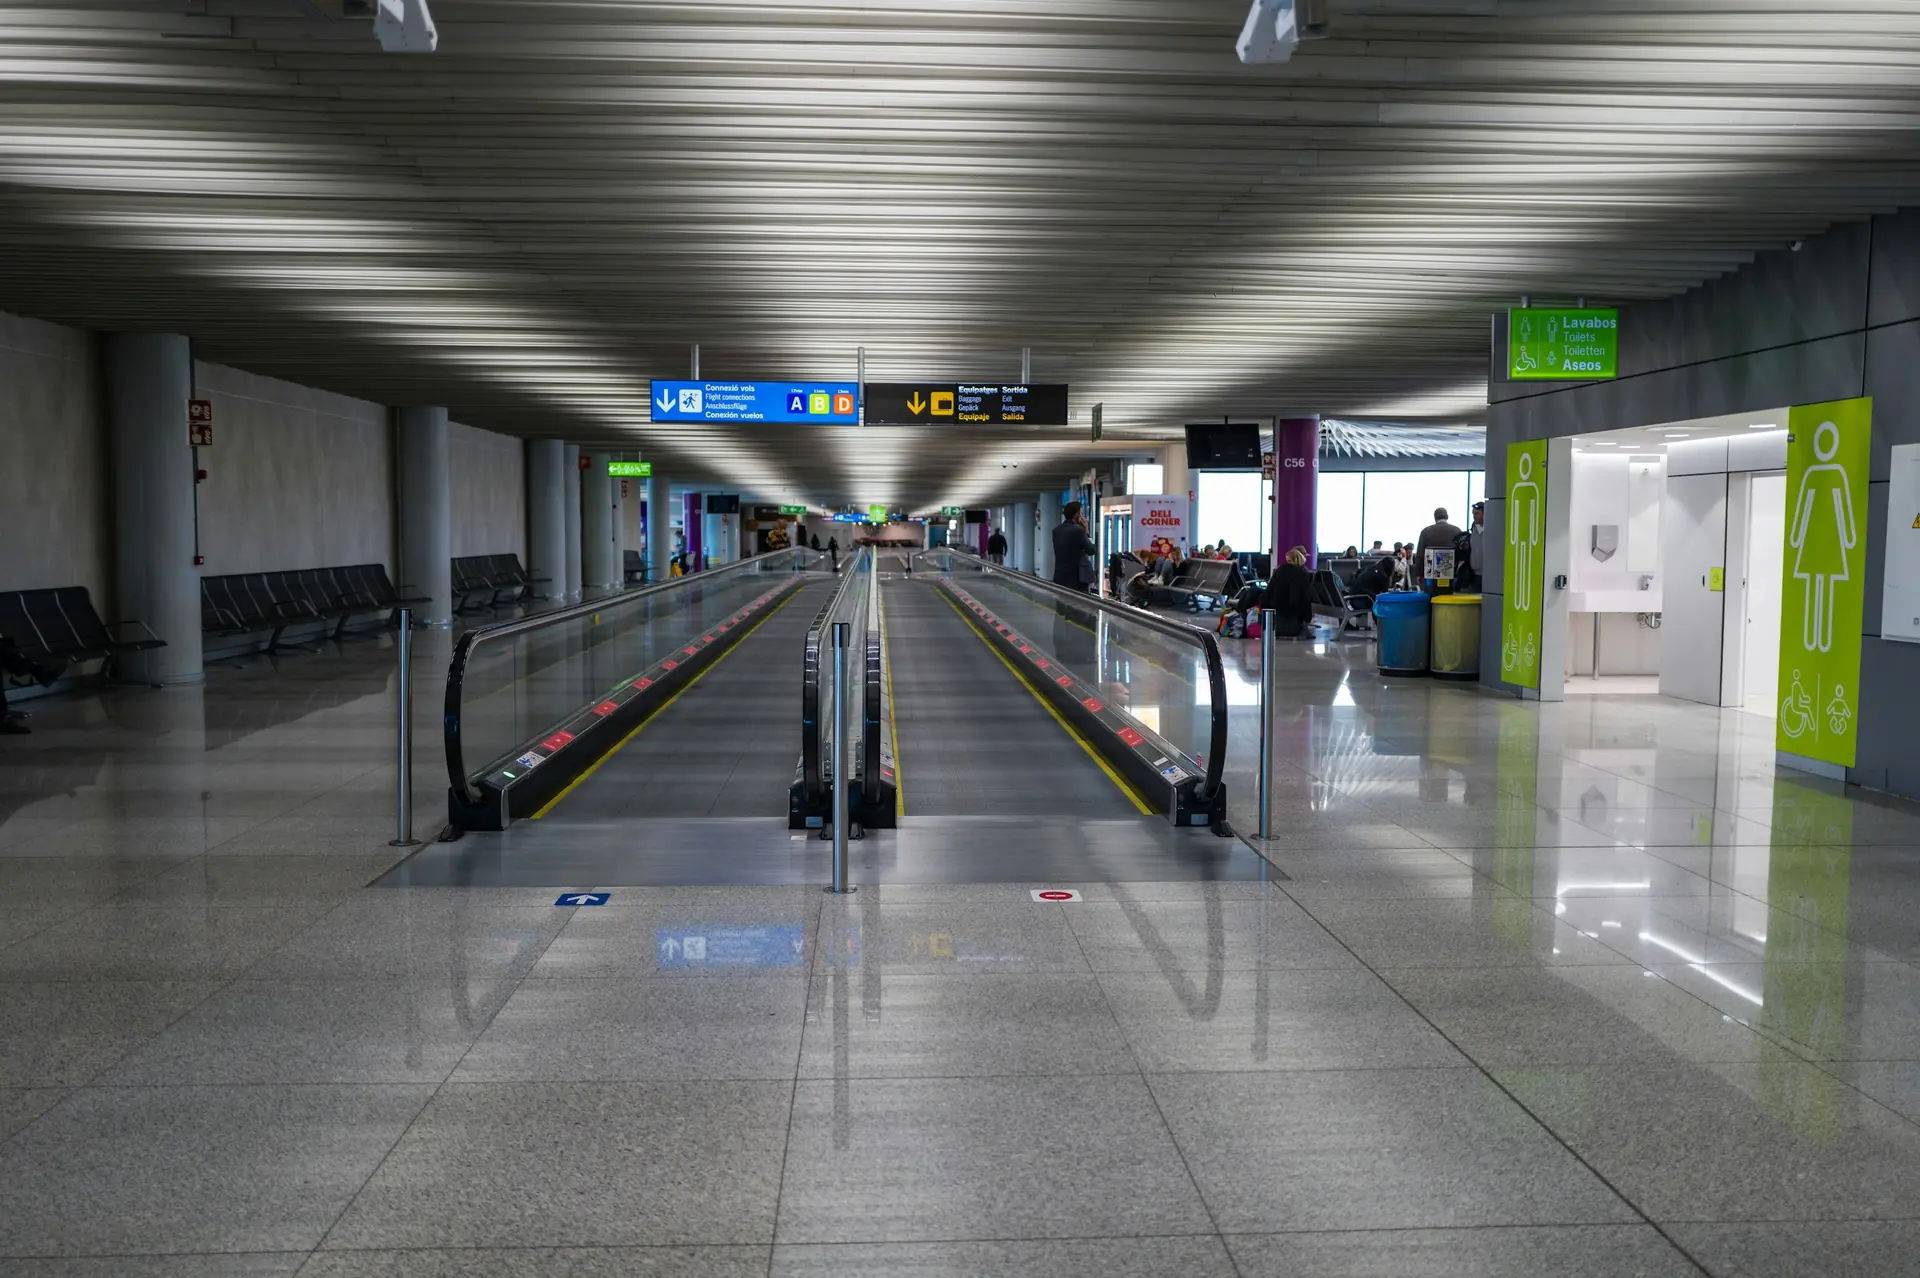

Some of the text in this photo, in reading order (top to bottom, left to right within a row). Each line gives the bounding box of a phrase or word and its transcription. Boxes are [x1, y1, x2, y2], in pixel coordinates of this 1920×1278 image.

[1563, 316, 1617, 329] Lavabos
[1563, 331, 1596, 343] Toilets
[1563, 345, 1606, 356] Toiletten
[1563, 358, 1601, 371] Aseos
[705, 383, 739, 391] Connexió
[958, 386, 998, 394] Equipatges
[1002, 386, 1028, 394] Sortida
[705, 393, 721, 401] Flight
[958, 395, 982, 403] Baggage
[705, 402, 748, 411] Anschlussflüge
[791, 396, 850, 411] A B D
[958, 404, 979, 412] Gepäck
[1002, 404, 1026, 412] Ausgang
[958, 413, 990, 421] Equipaje
[1284, 458, 1305, 468] C56
[1150, 510, 1172, 518] DELI
[1141, 518, 1181, 526] CORNER
